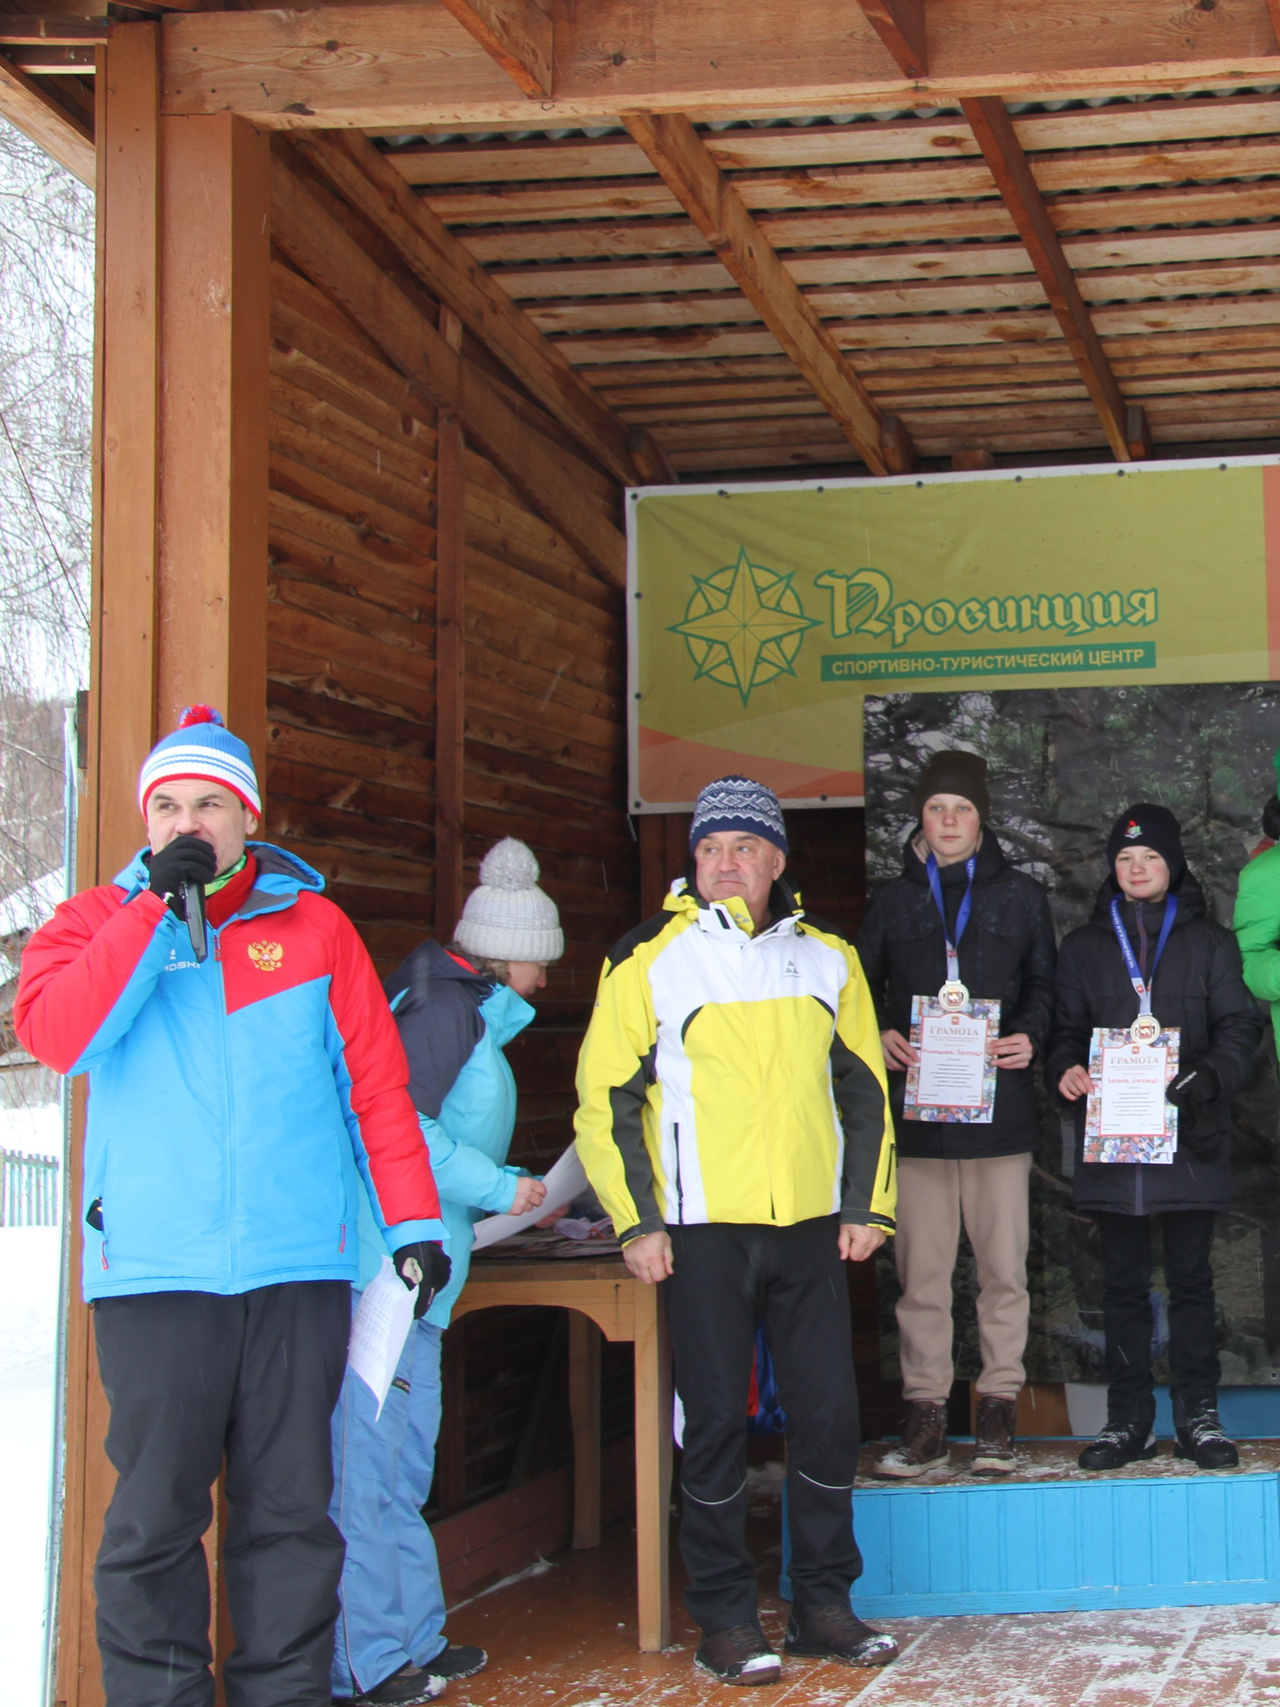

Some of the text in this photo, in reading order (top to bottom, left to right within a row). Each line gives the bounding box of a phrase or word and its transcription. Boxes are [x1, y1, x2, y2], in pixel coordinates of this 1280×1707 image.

[813, 567, 1159, 649] Провинция
[831, 648, 1145, 676] СПОРТИВНО-ТУРИСТИЧЕСКИЙ ЦЕНТР
[929, 1026, 979, 1036] ГРАМОТА
[1110, 1056, 1159, 1065] ГРАМОТА
